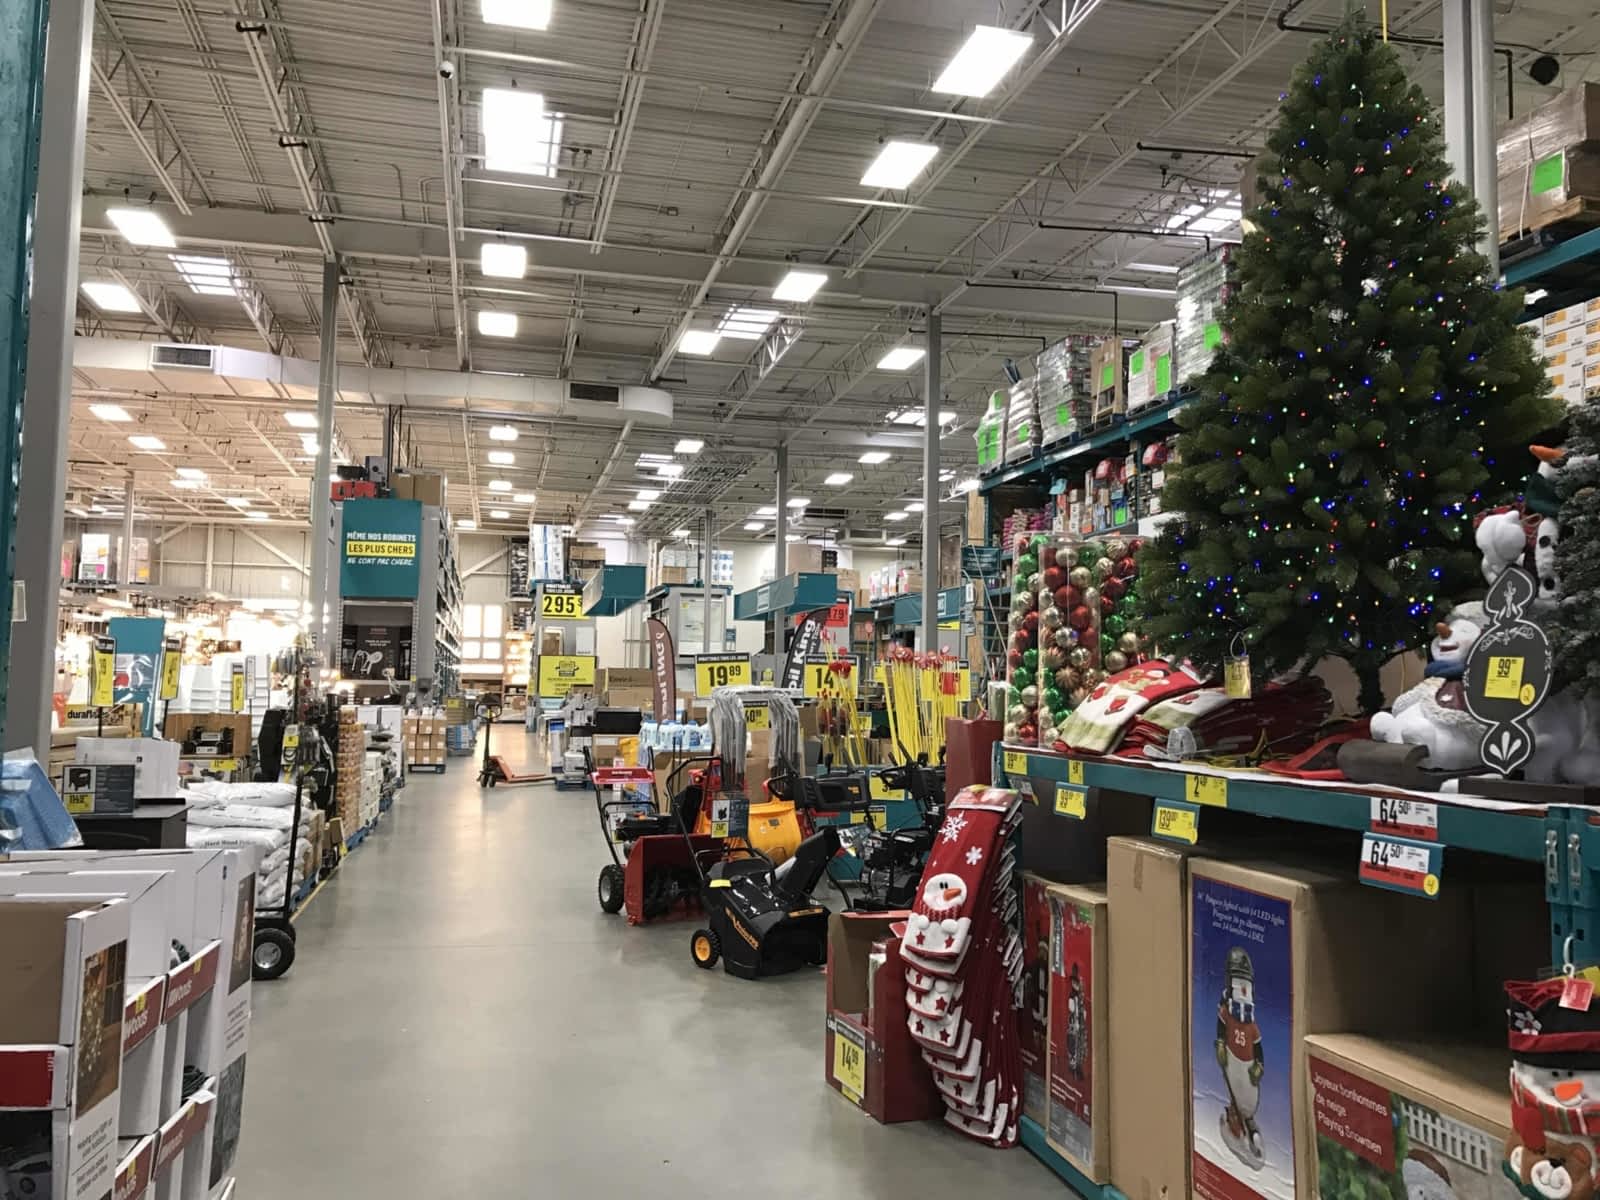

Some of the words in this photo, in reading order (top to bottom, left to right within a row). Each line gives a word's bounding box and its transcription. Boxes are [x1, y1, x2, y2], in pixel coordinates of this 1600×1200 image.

[348, 543, 364, 553] LES
[365, 544, 386, 554] PLUS
[387, 545, 414, 555] CHERS
[543, 595, 575, 613] 295
[793, 619, 816, 665] King
[707, 665, 729, 687] 19
[1380, 799, 1398, 824] 64
[1370, 841, 1389, 869] 64
[1234, 1029, 1246, 1047] 25
[842, 1042, 852, 1072] 14
